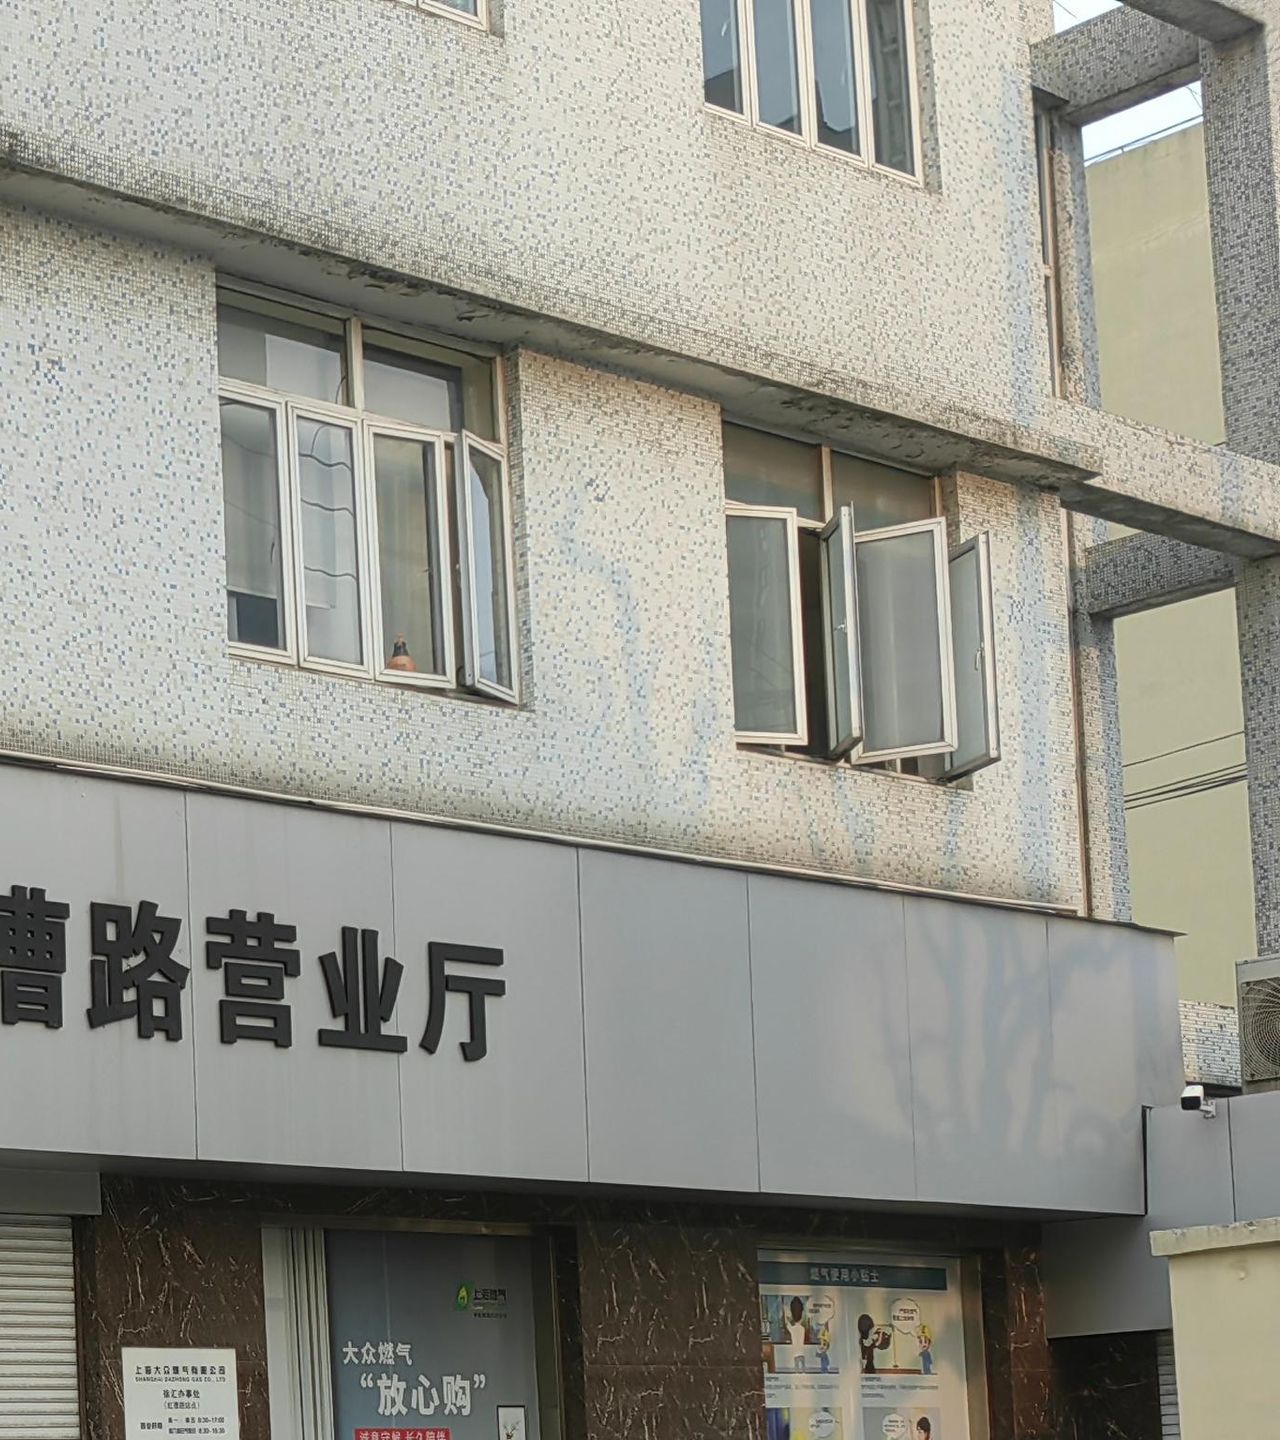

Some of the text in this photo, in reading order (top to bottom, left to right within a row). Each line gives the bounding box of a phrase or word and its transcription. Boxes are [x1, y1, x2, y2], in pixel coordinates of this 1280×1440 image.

[343, 1341, 412, 1365] 大众燃气
[135, 1365, 226, 1375] 上海大众燃气有限公司
[163, 1389, 200, 1399] 徐汇办事处
[360, 1373, 486, 1416] “放心购”
